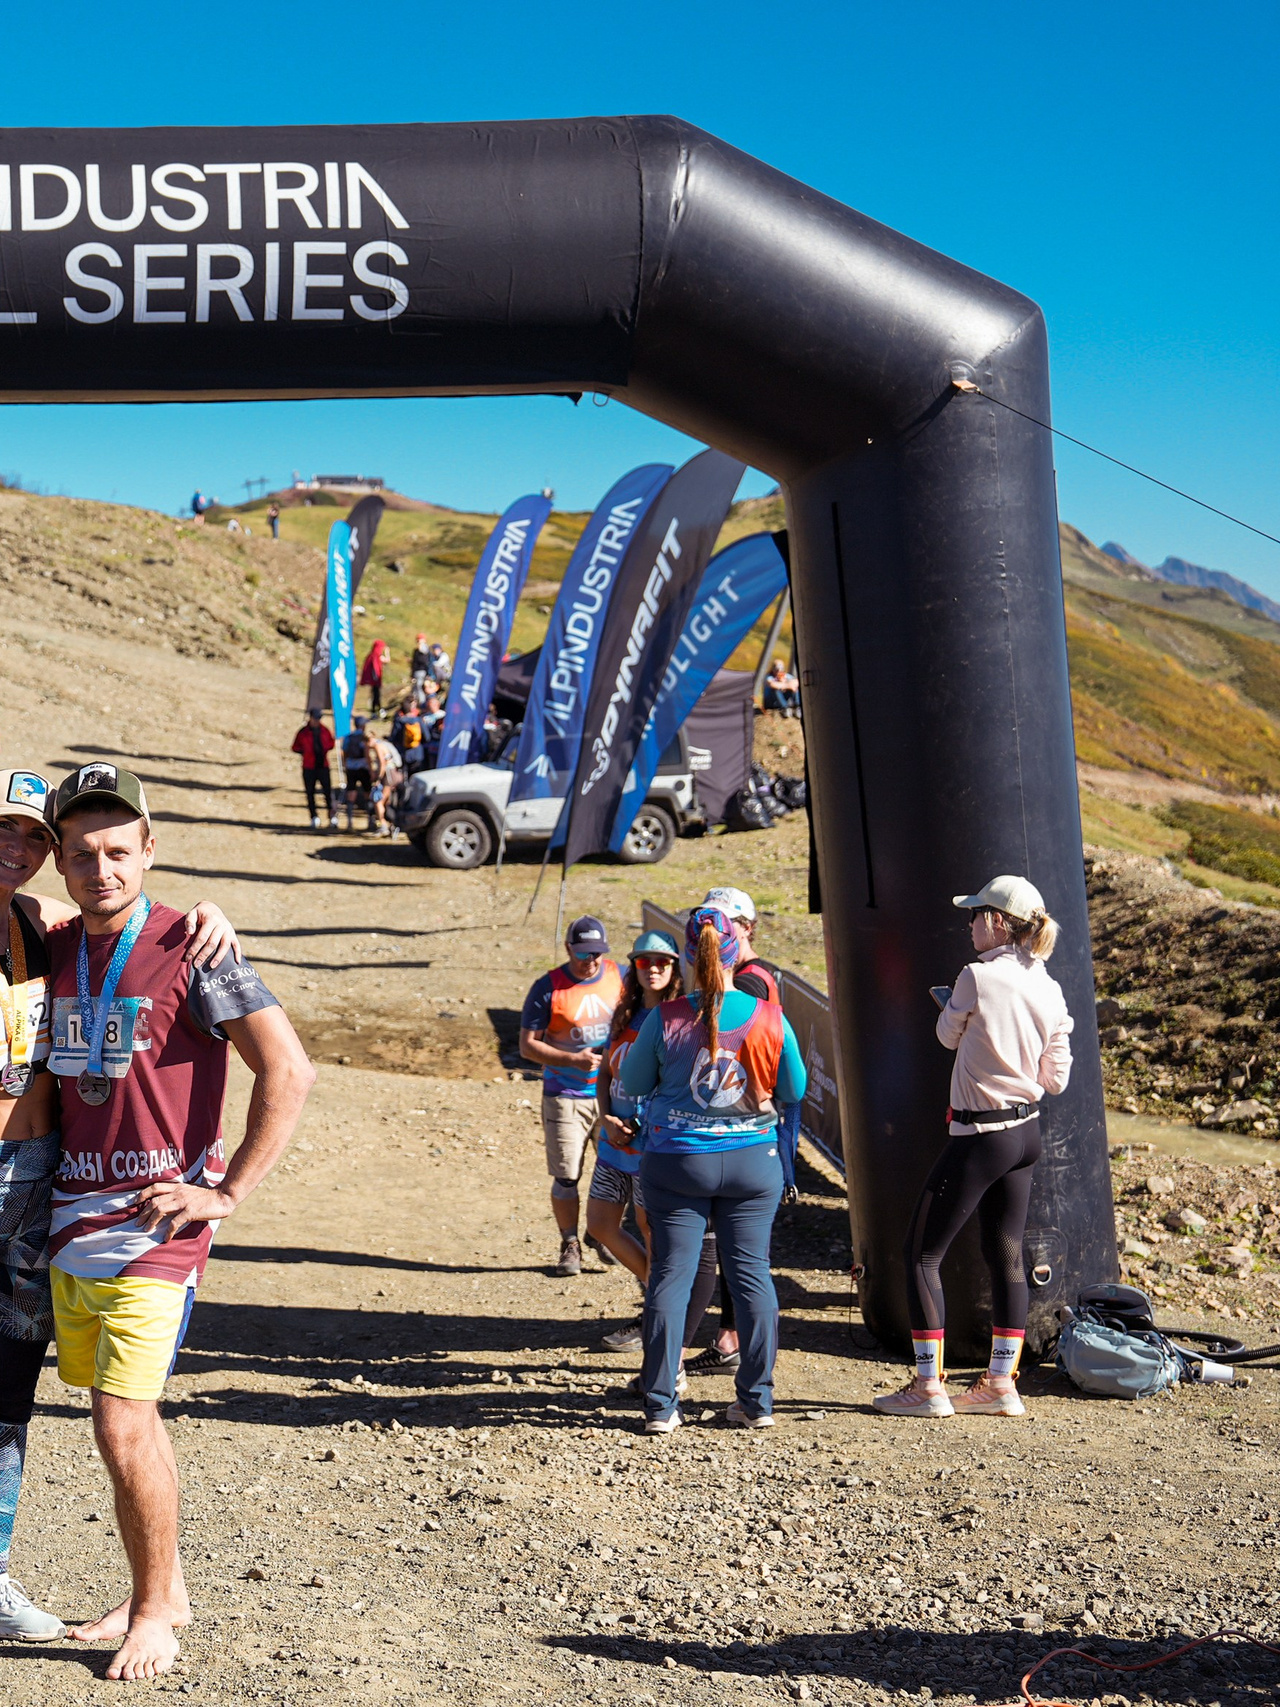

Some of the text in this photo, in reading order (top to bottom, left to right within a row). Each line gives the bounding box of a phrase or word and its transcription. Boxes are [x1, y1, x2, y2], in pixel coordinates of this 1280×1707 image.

[62, 240, 410, 324] SERIES
[460, 518, 532, 711] ALPINDUSTRIA
[543, 497, 643, 738] ALPINDUSTRIA
[600, 516, 682, 748] DYNAFIT
[14, 1009, 22, 1035] ALPIKA
[570, 1022, 610, 1042] CRE
